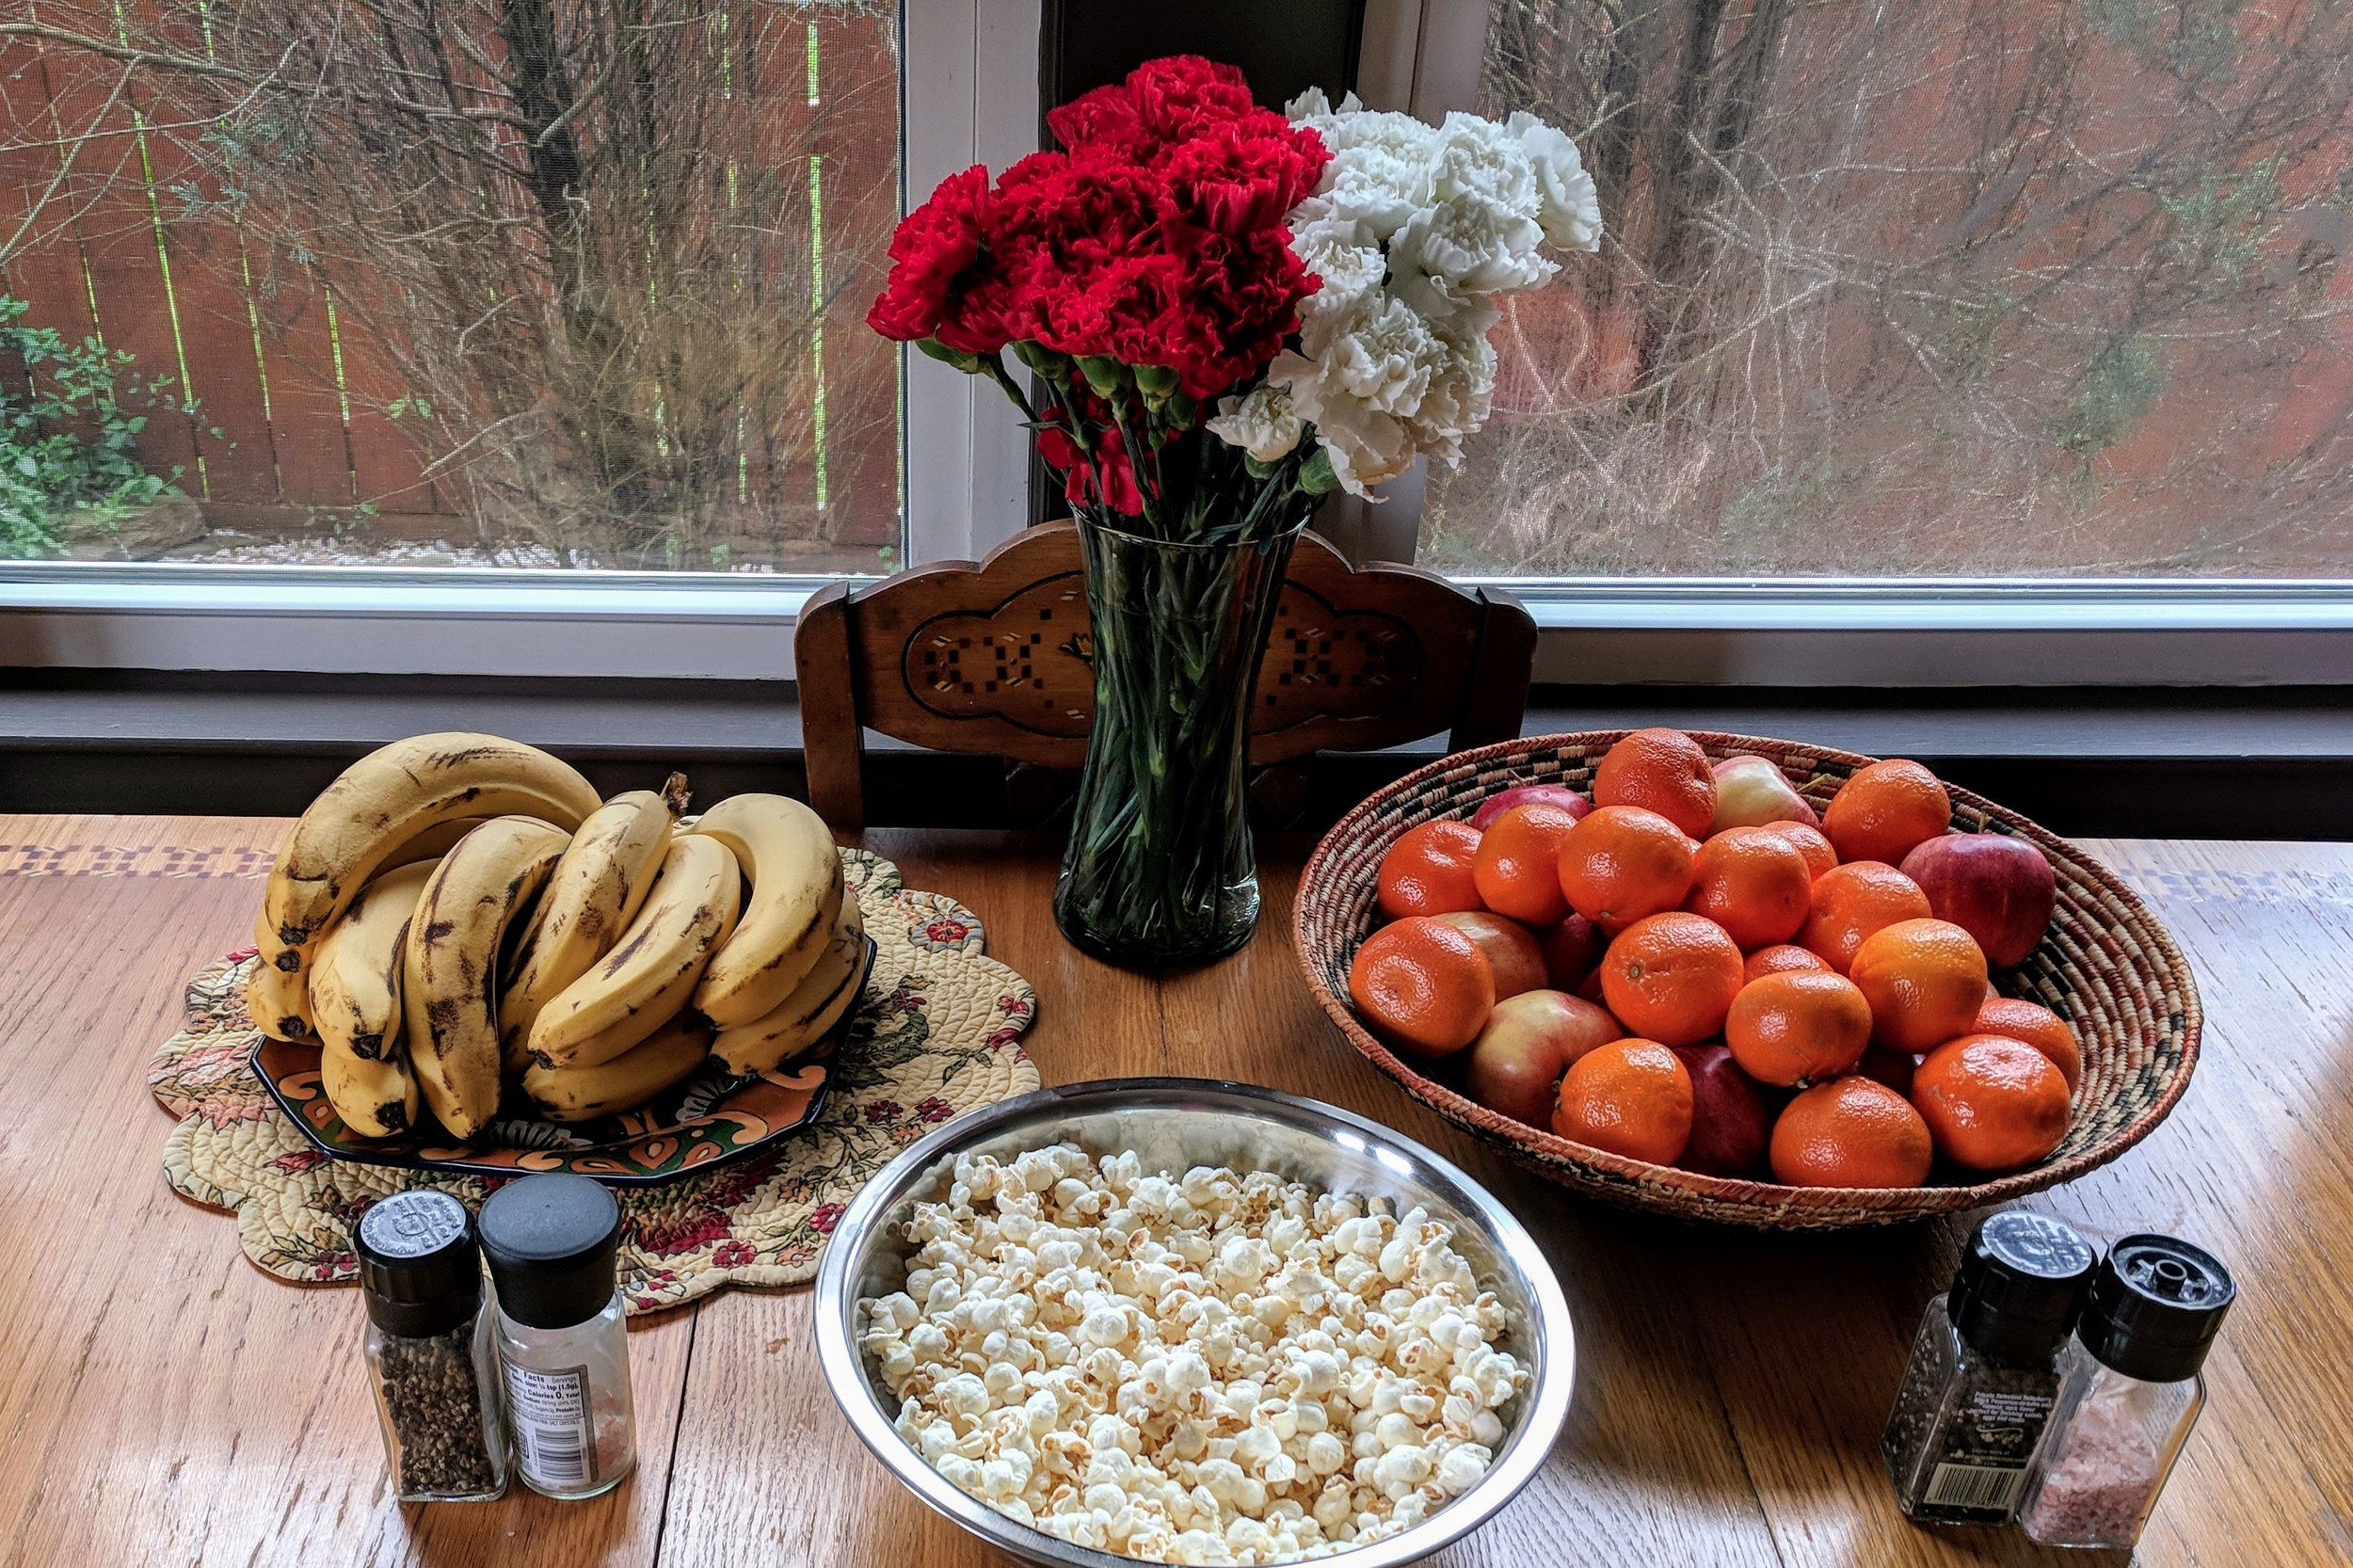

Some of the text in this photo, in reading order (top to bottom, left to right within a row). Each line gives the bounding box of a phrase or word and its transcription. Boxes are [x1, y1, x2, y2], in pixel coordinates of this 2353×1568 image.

[523, 1371, 545, 1383] Facts
[527, 1388, 554, 1400] Calories
[555, 1391, 565, 1400] 0,
